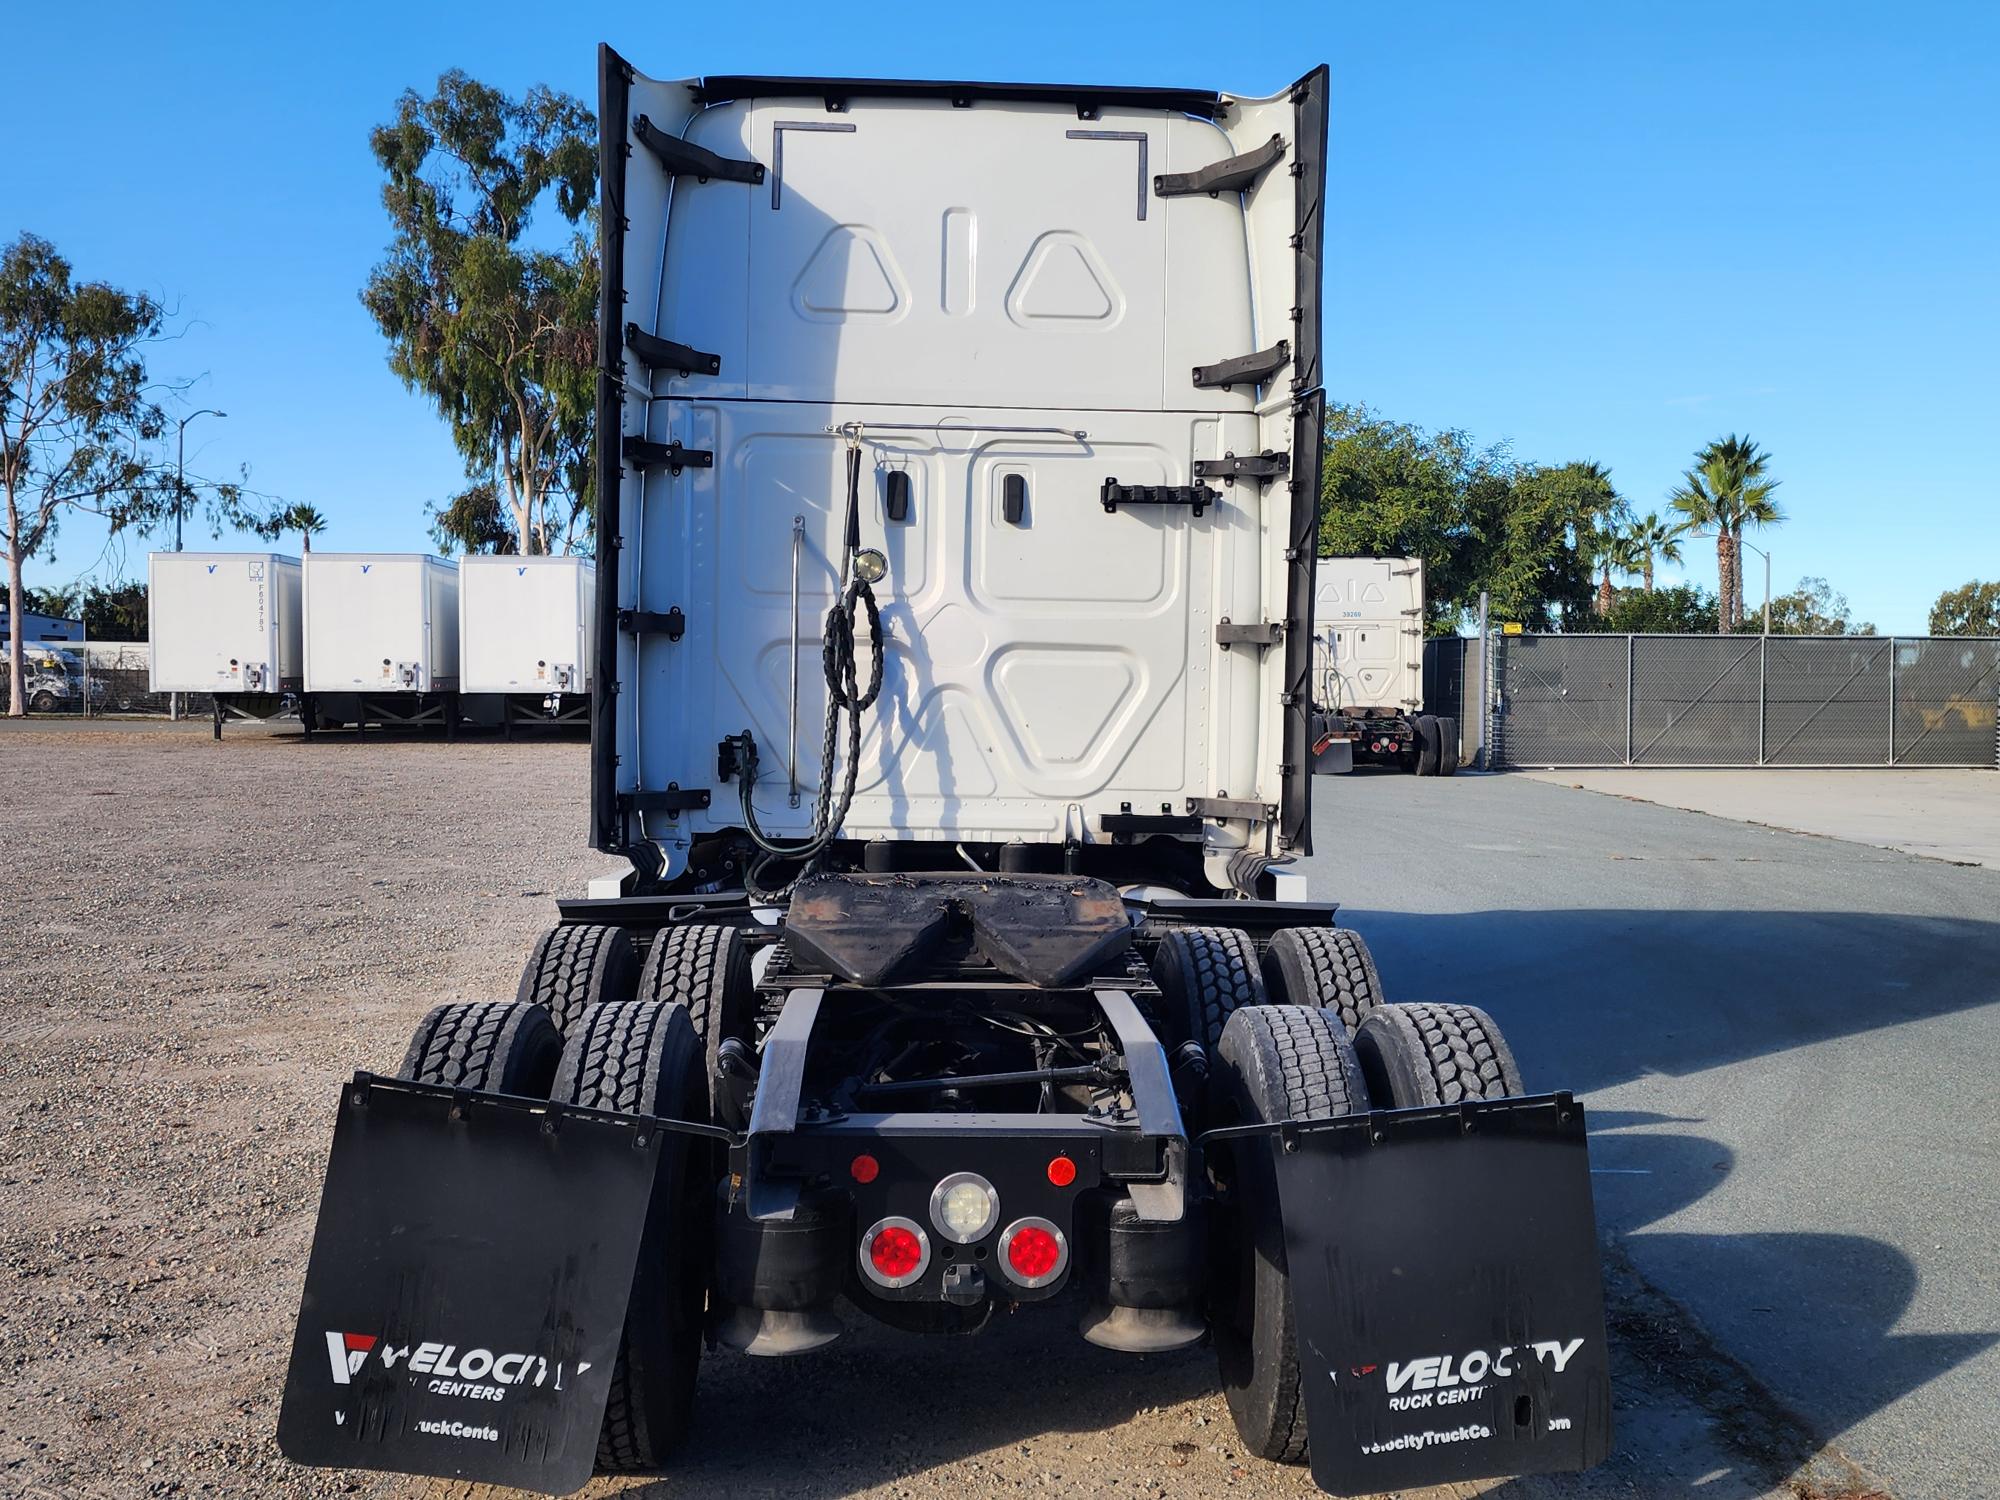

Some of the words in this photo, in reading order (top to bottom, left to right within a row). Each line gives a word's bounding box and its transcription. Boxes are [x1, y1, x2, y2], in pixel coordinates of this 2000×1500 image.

[379, 1342, 592, 1391] VELOCI
[1385, 1338, 1584, 1393] VELOCTY
[428, 1379, 505, 1402] CENTERS
[1389, 1393, 1433, 1411] RUCK
[1437, 1384, 1497, 1405] CENT
